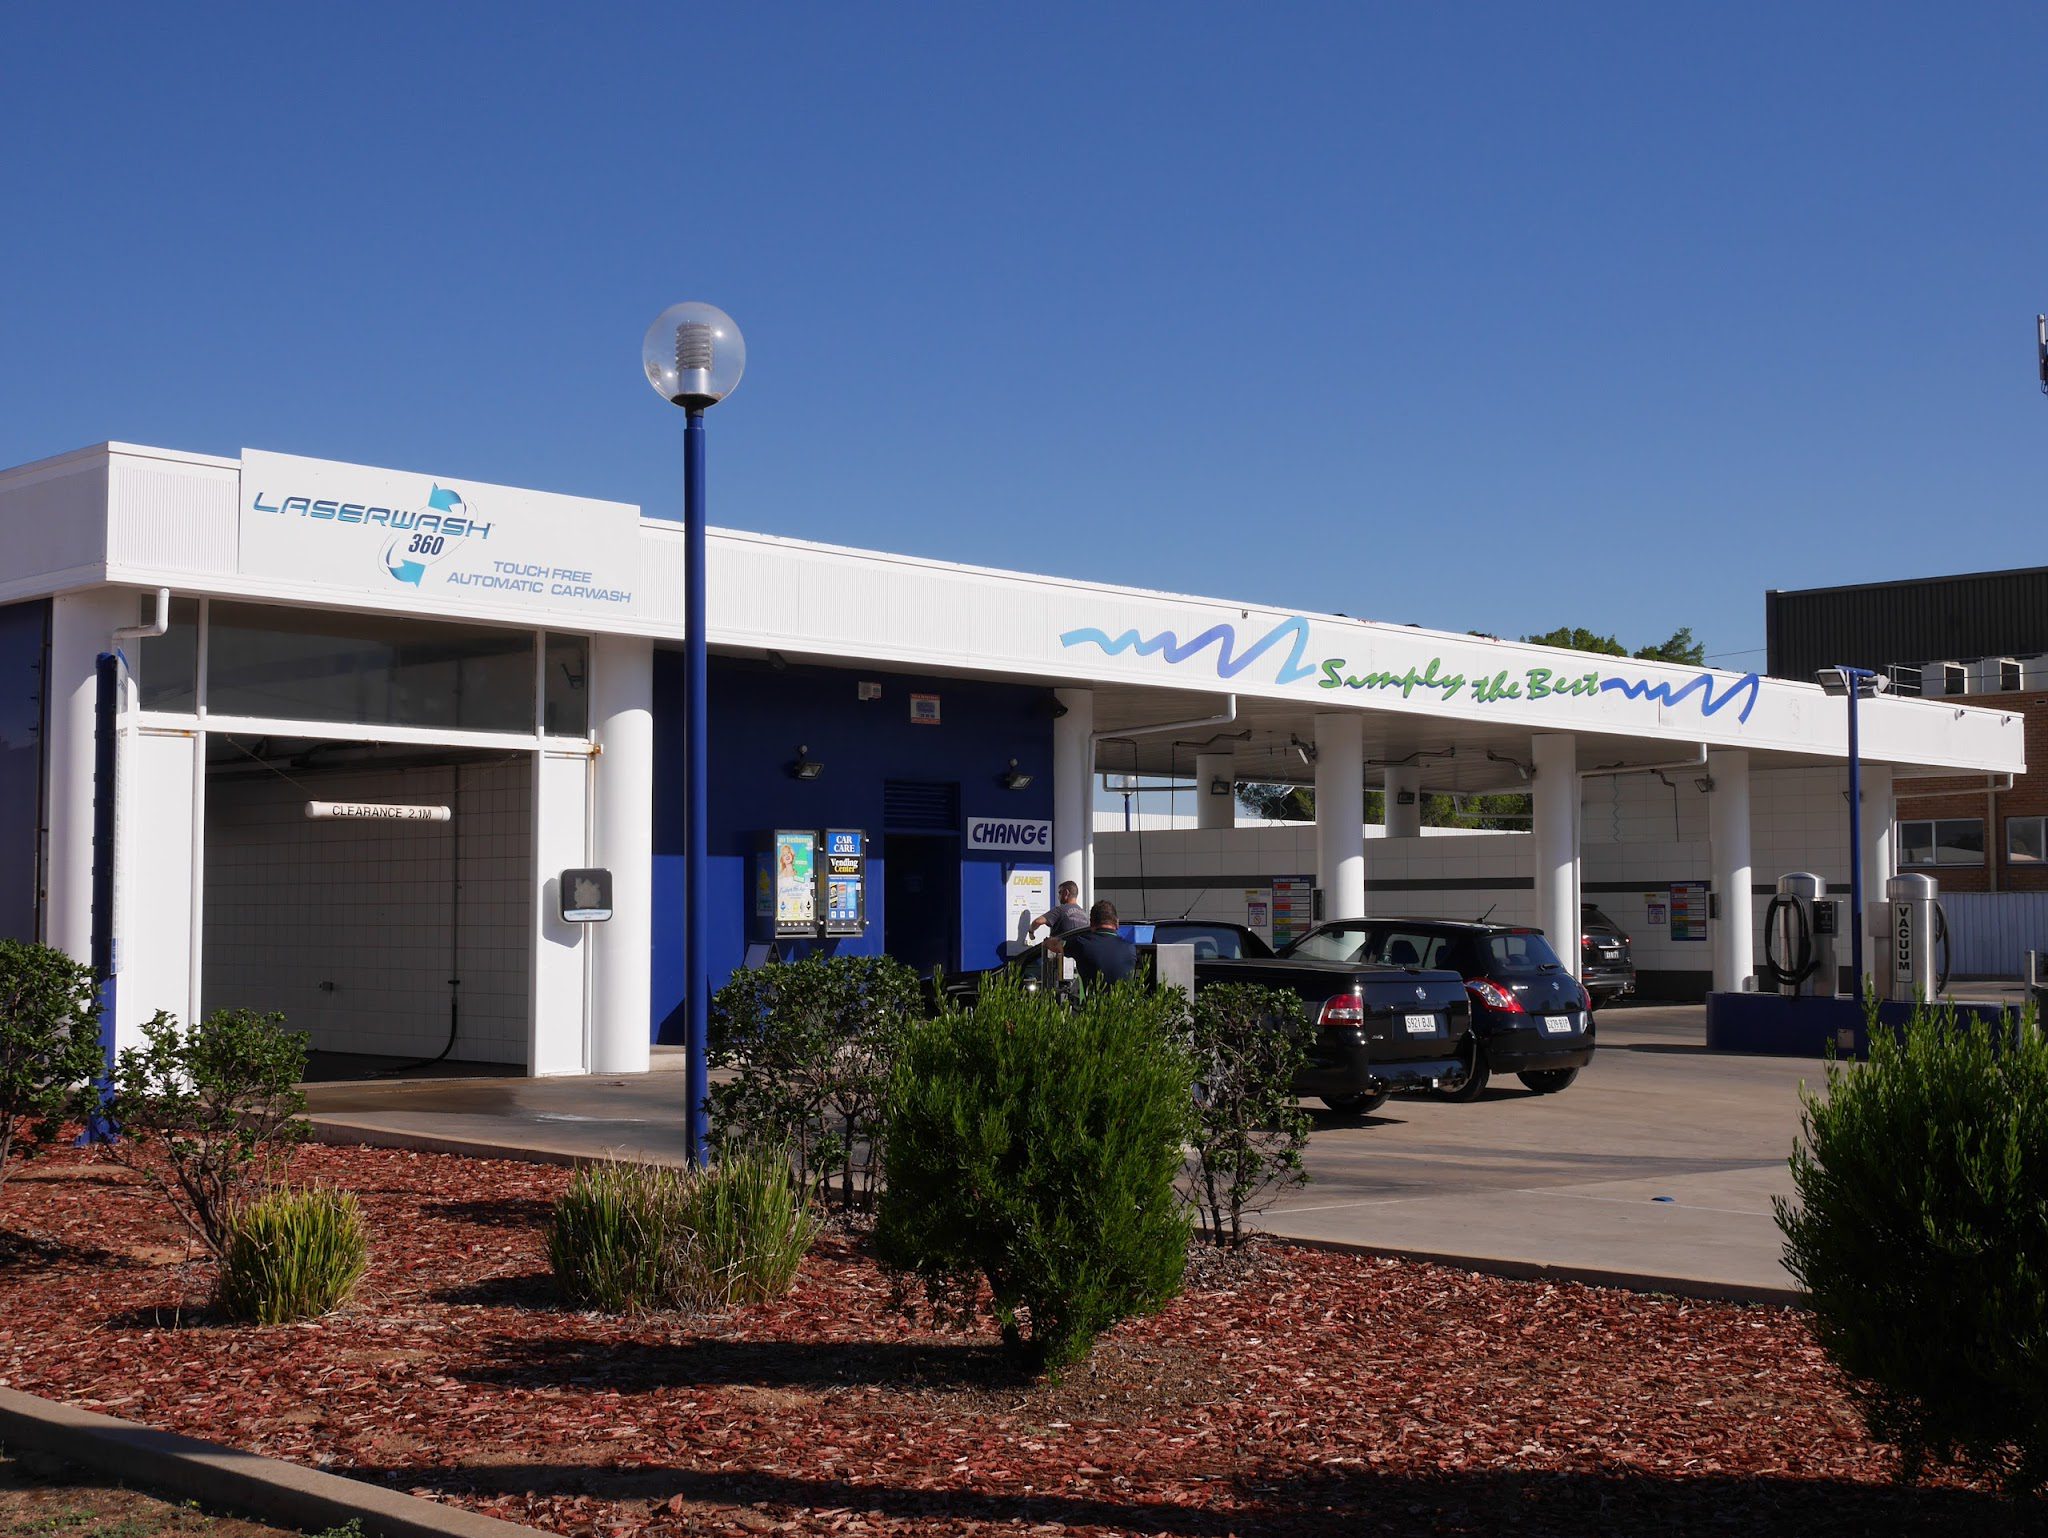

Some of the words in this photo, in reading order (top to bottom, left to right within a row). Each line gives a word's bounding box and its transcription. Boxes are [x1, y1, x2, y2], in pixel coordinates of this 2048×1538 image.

[253, 491, 492, 540] LASERWASH
[408, 533, 445, 555] 360
[494, 561, 549, 578] TOUCH
[551, 569, 592, 583] FREE
[447, 572, 544, 593] AUTOMATIC
[551, 583, 631, 603] CARWASH
[1318, 657, 1466, 701] Simply
[1471, 670, 1522, 703] the
[1526, 668, 1599, 700] Best
[332, 805, 402, 818] CLEARANCE
[408, 808, 432, 819] 2.1M
[836, 835, 853, 844] CAR
[972, 823, 1048, 845] CHANGE
[833, 844, 856, 853] CARE
[830, 858, 858, 868] Vending
[834, 865, 856, 873] Center
[1013, 876, 1043, 886] CHANGE
[1898, 907, 1910, 971] VACUUM
